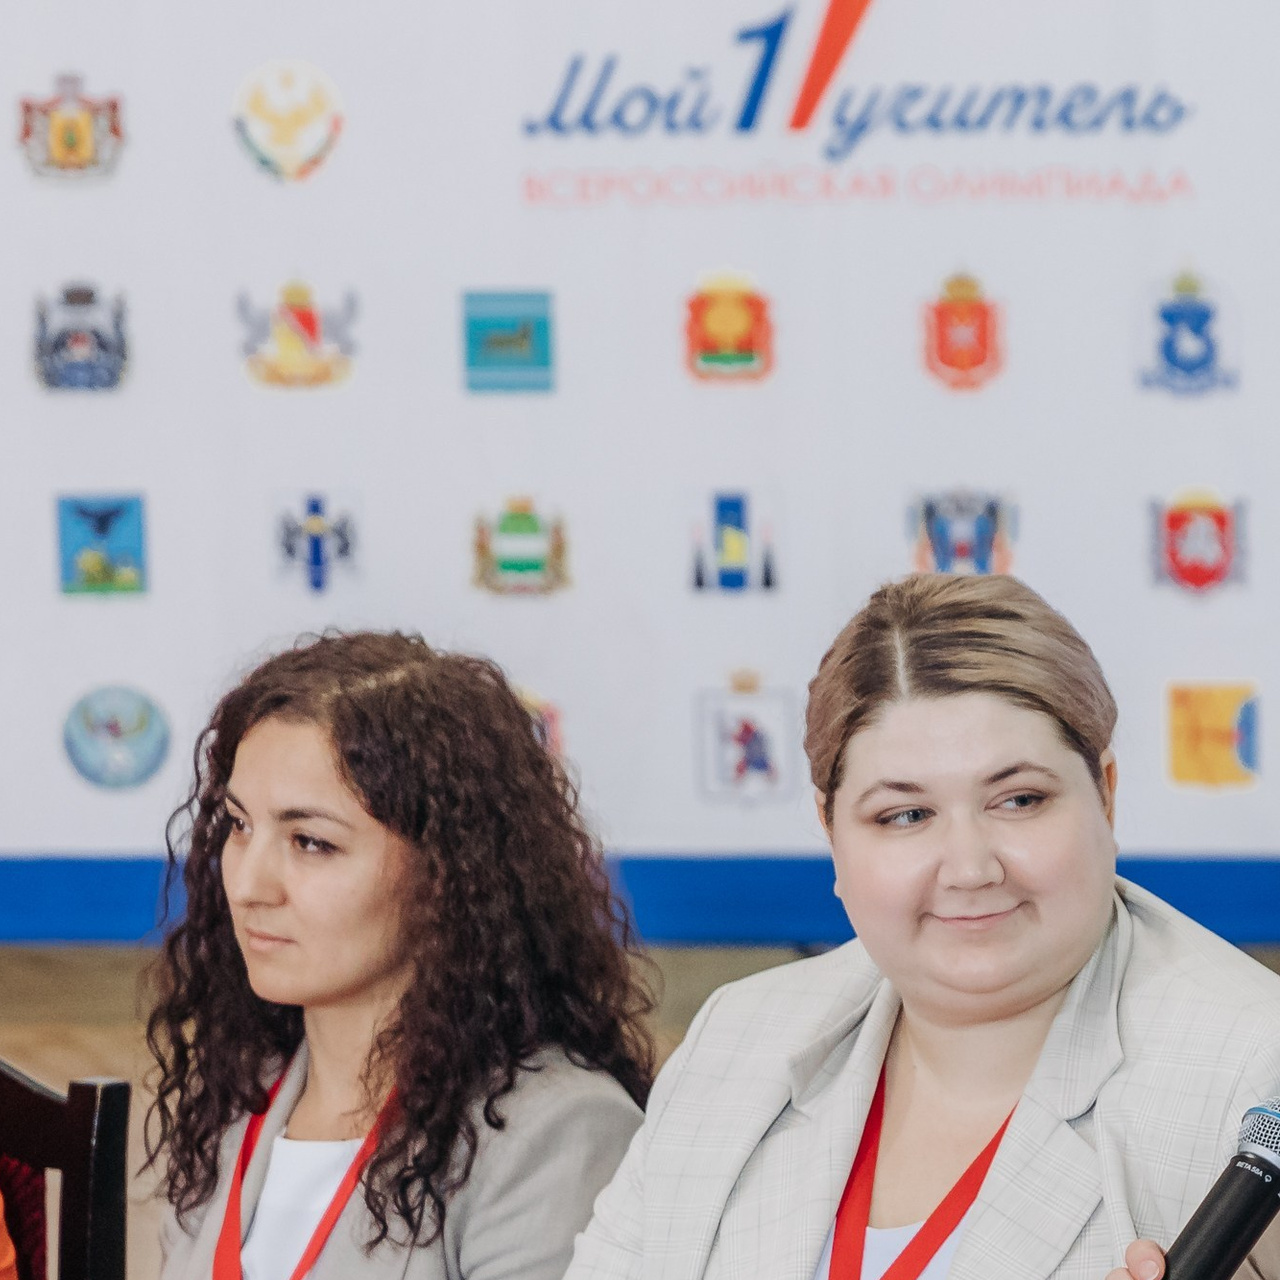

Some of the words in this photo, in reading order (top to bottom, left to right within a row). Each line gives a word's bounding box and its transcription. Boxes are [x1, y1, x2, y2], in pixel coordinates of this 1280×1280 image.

[521, 53, 714, 138] Мой
[824, 82, 1192, 162] учитель
[521, 161, 896, 204] ВСЕРОССИЙСКАЯ
[909, 163, 1196, 204] ОЛИМПИАДА
